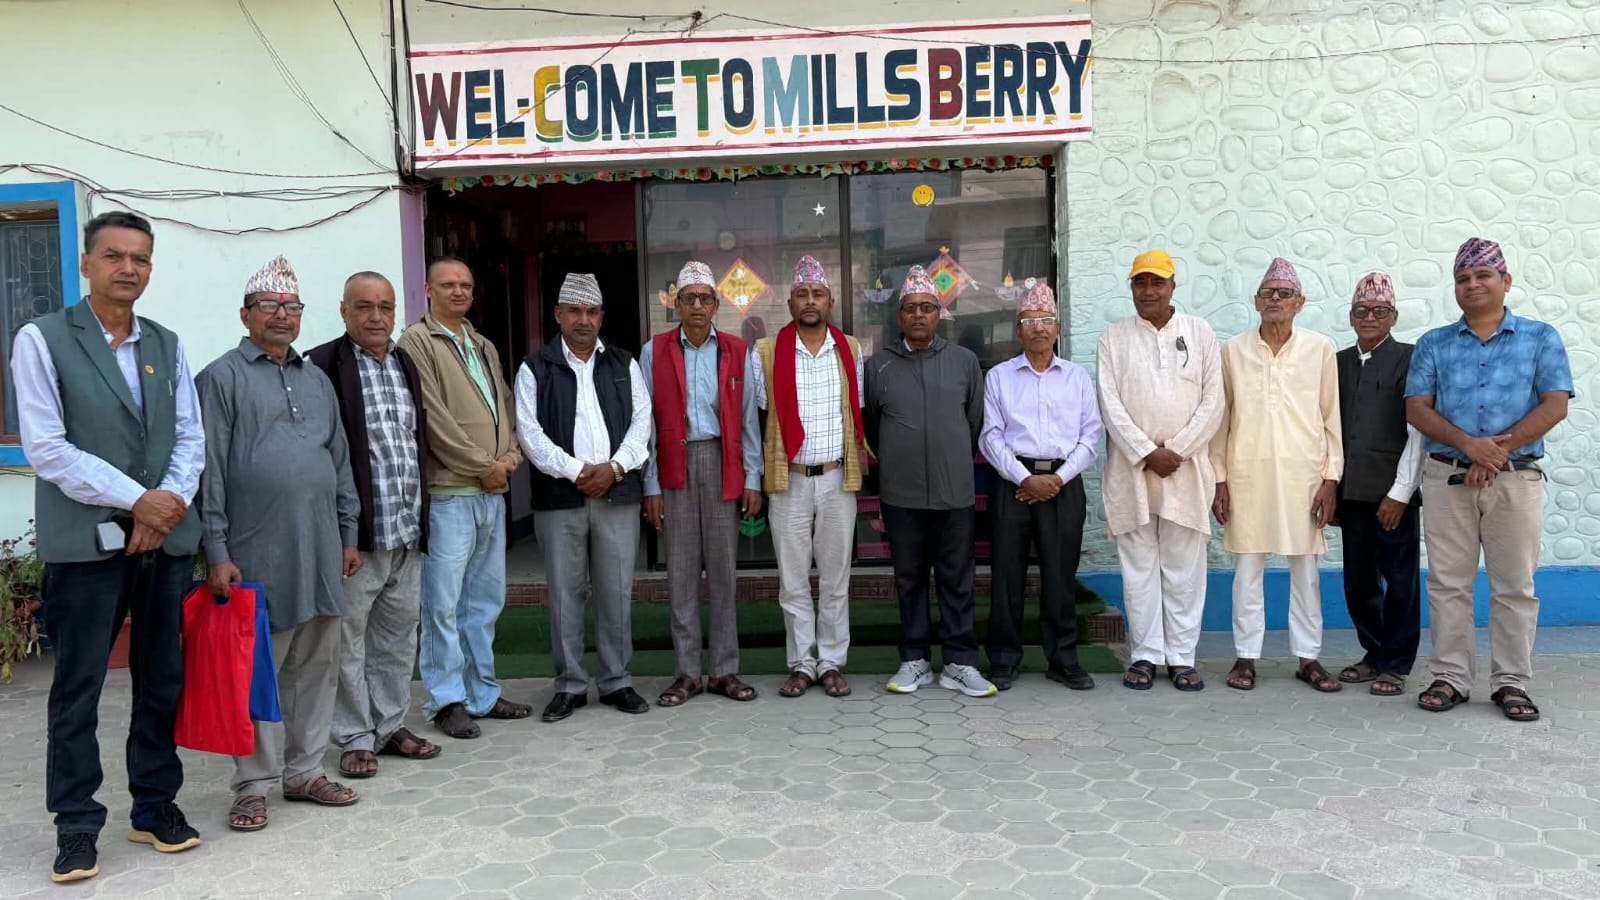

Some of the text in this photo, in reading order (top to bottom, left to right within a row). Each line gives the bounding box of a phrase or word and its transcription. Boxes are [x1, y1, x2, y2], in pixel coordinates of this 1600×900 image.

[415, 39, 1093, 146] WEL-COME TO MILLS BERRY
